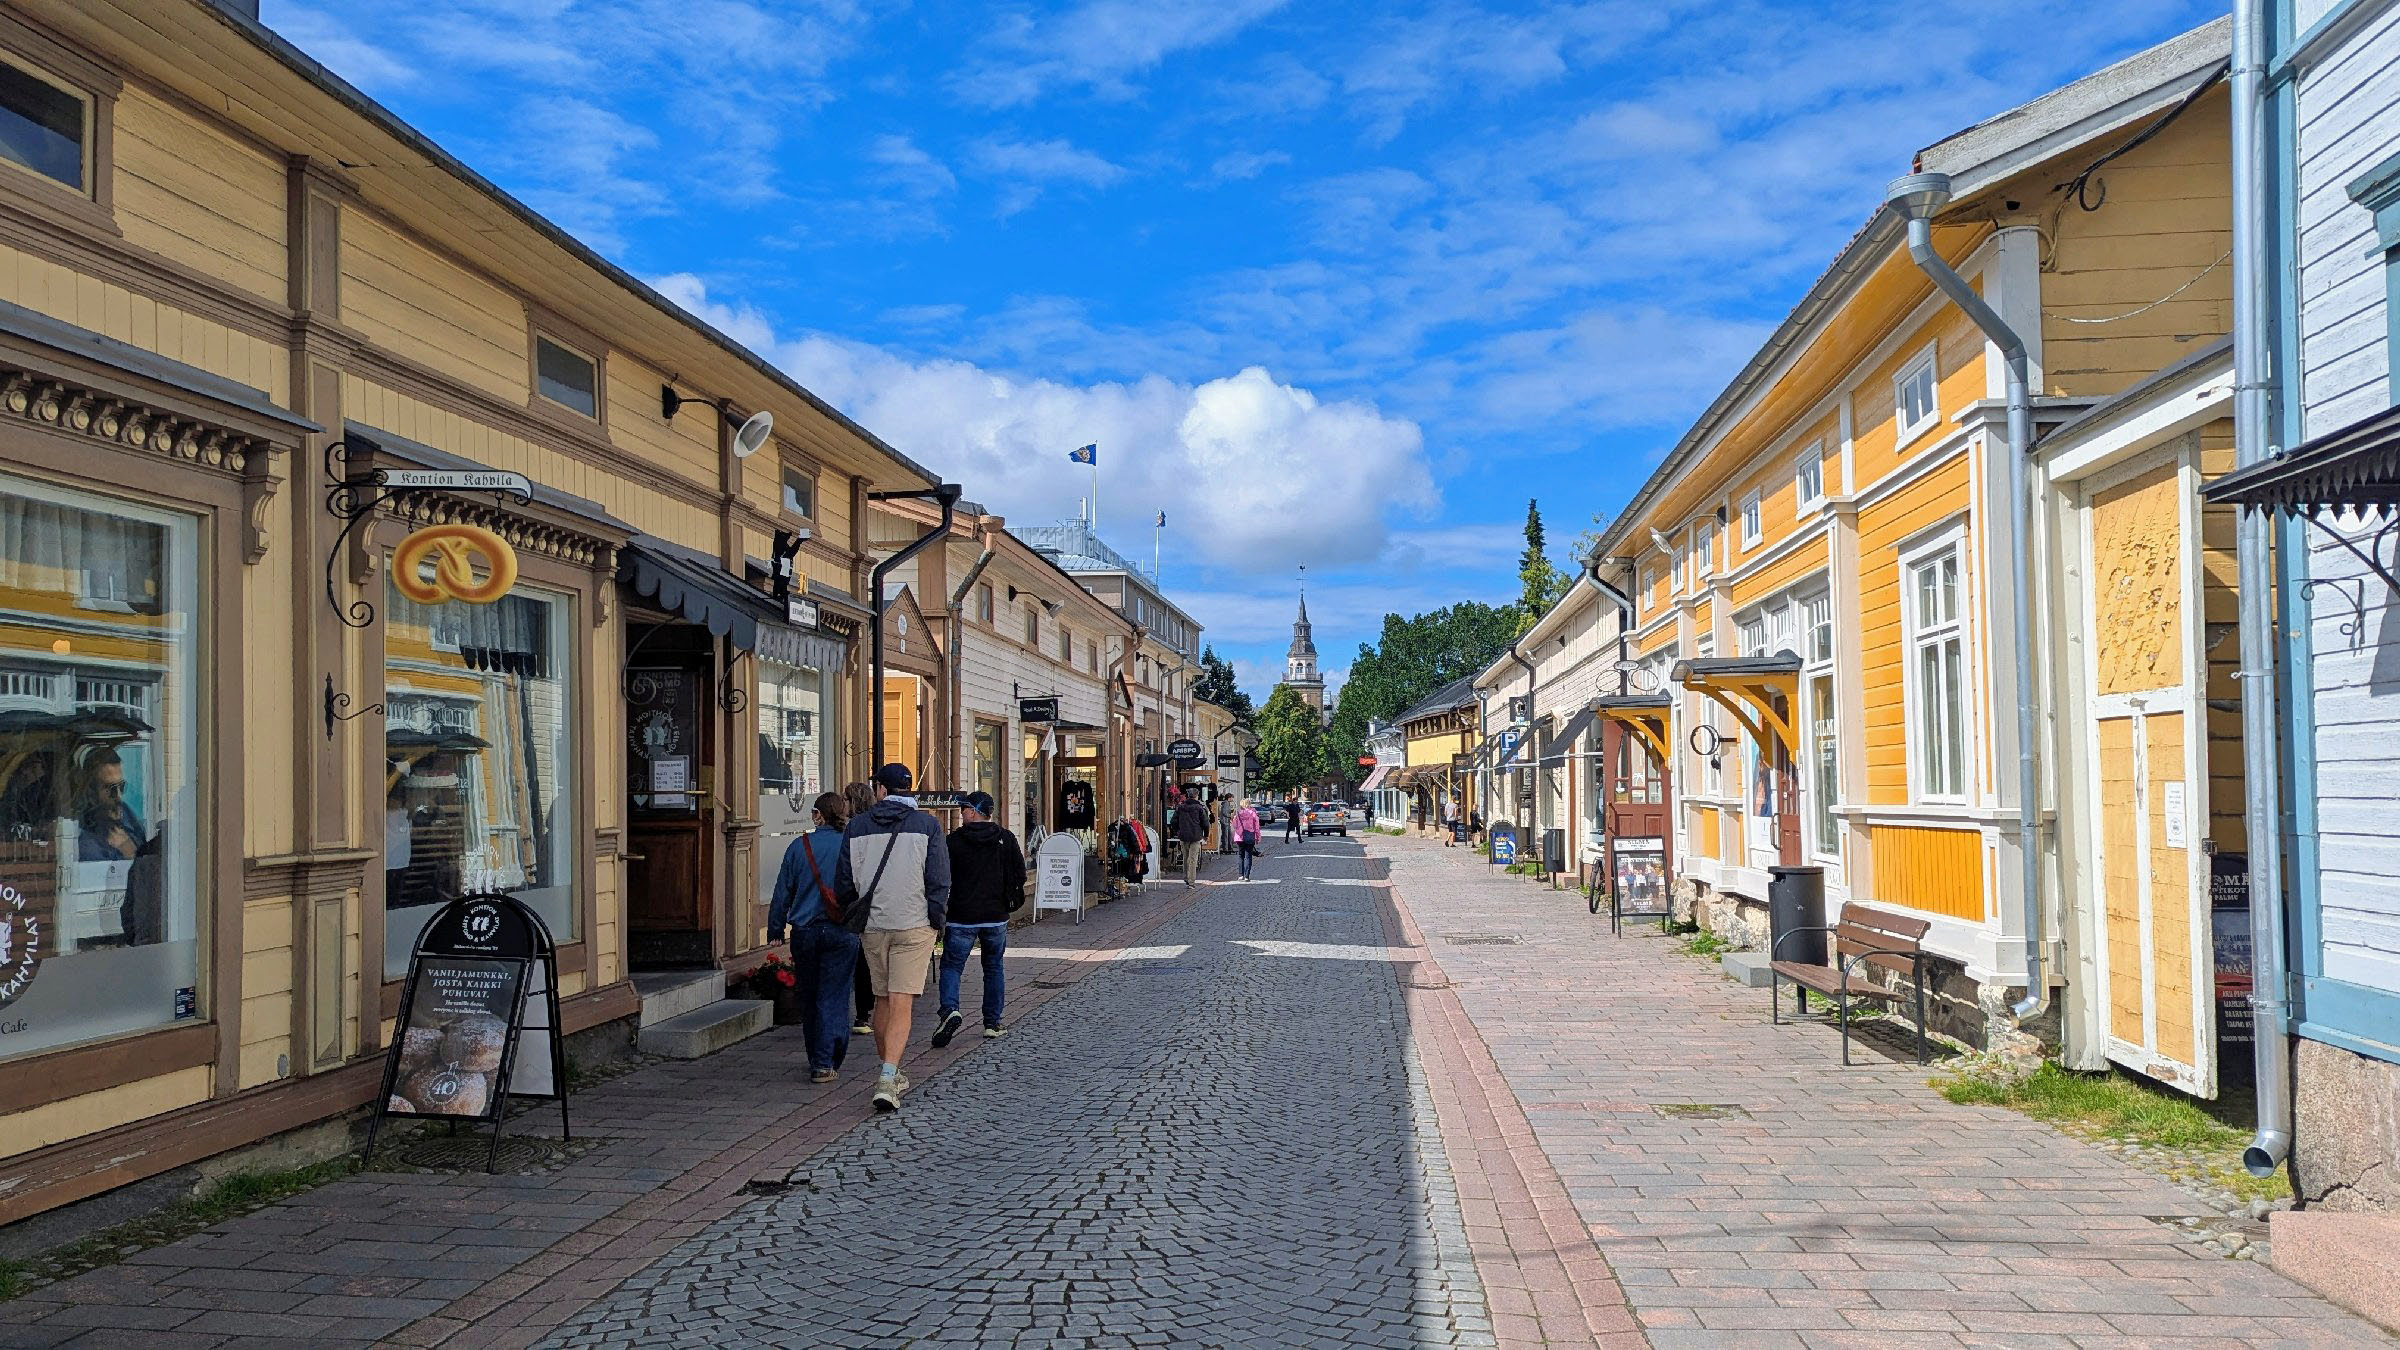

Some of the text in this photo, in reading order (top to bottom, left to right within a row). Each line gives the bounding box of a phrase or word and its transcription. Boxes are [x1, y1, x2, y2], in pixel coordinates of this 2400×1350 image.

[400, 472, 513, 486] Kontion Kahvila
[1504, 733, 1517, 748] P
[0, 916, 39, 1000] KAHVILAT
[433, 979, 502, 989] JOSTA KAIKKI
[1, 1018, 28, 1035] Cafe
